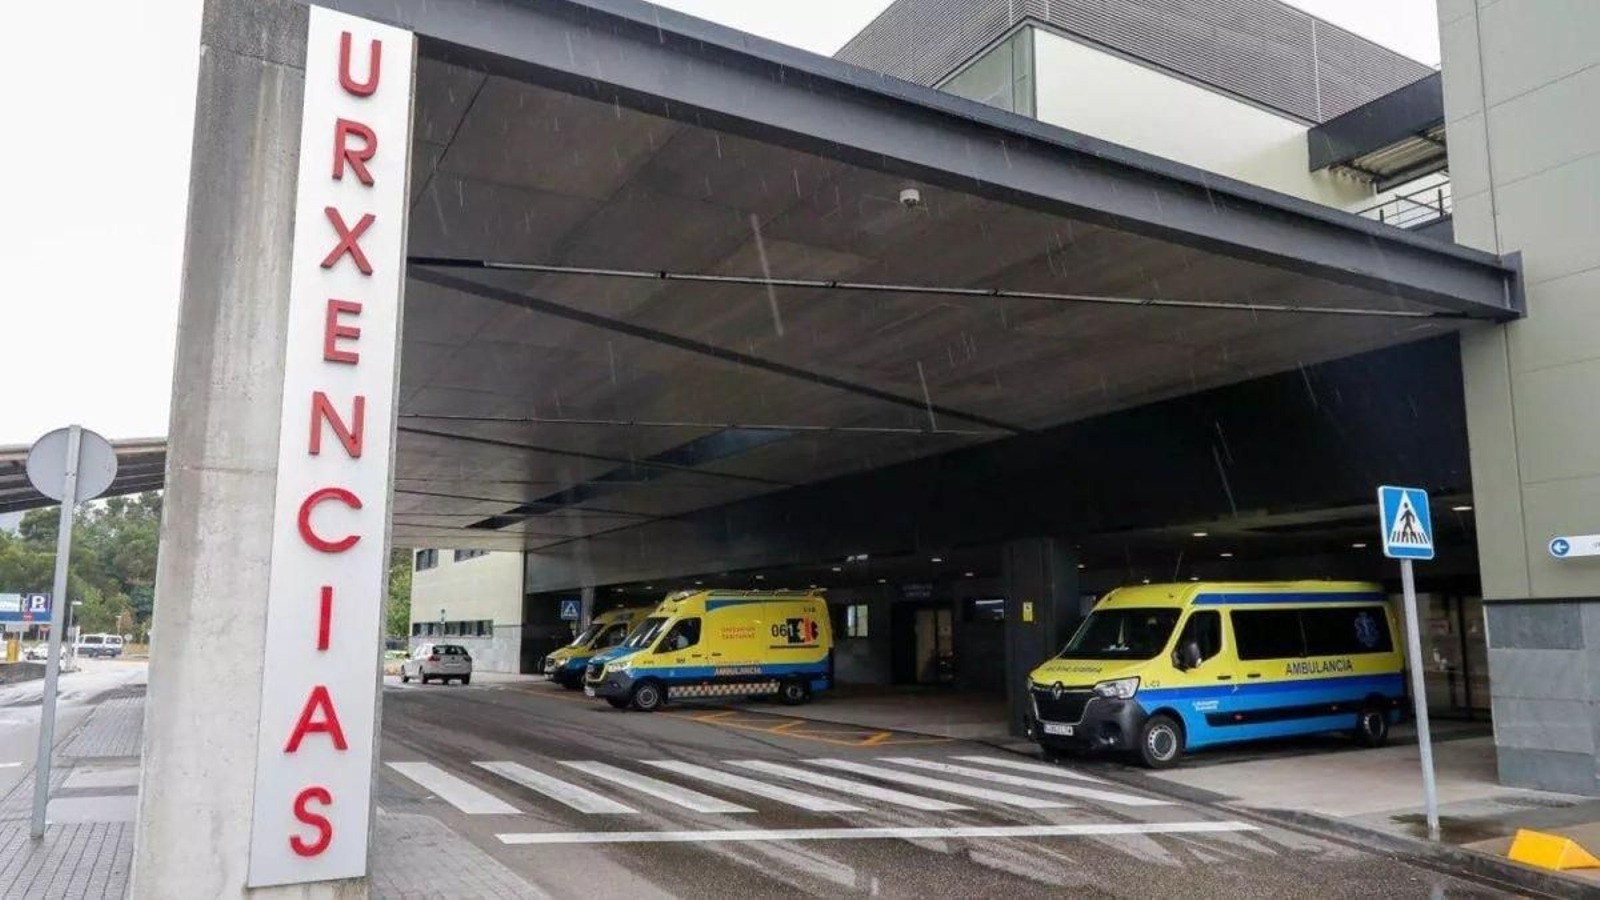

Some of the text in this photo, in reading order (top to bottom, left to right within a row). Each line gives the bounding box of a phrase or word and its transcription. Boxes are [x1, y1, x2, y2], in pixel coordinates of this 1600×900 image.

[284, 32, 382, 857] URXENCIAS
[31, 595, 46, 611] P
[771, 624, 794, 637] 061
[1285, 659, 1354, 675] AMBULANCIA
